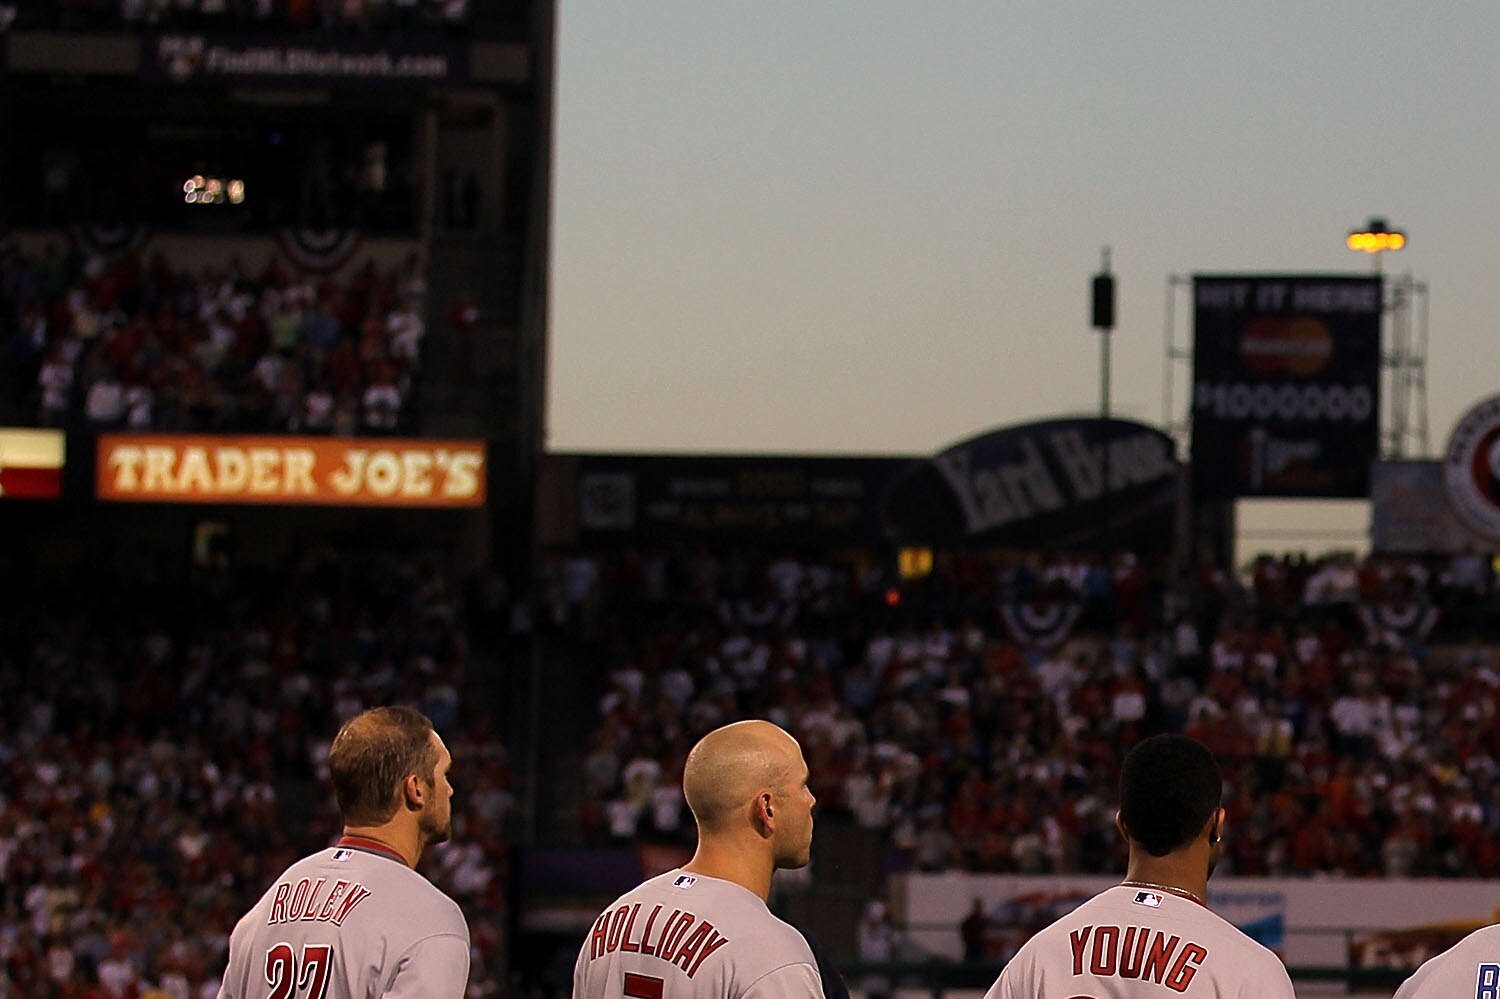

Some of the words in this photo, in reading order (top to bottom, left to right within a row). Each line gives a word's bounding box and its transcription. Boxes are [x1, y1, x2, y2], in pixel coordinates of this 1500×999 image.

[109, 444, 315, 495] TRADER
[330, 448, 482, 498] JOE'S
[934, 434, 1066, 536] Yard
[268, 877, 370, 926] ROLEN
[590, 902, 728, 978] HOLLIDAY
[1069, 925, 1208, 993] YOUNG
